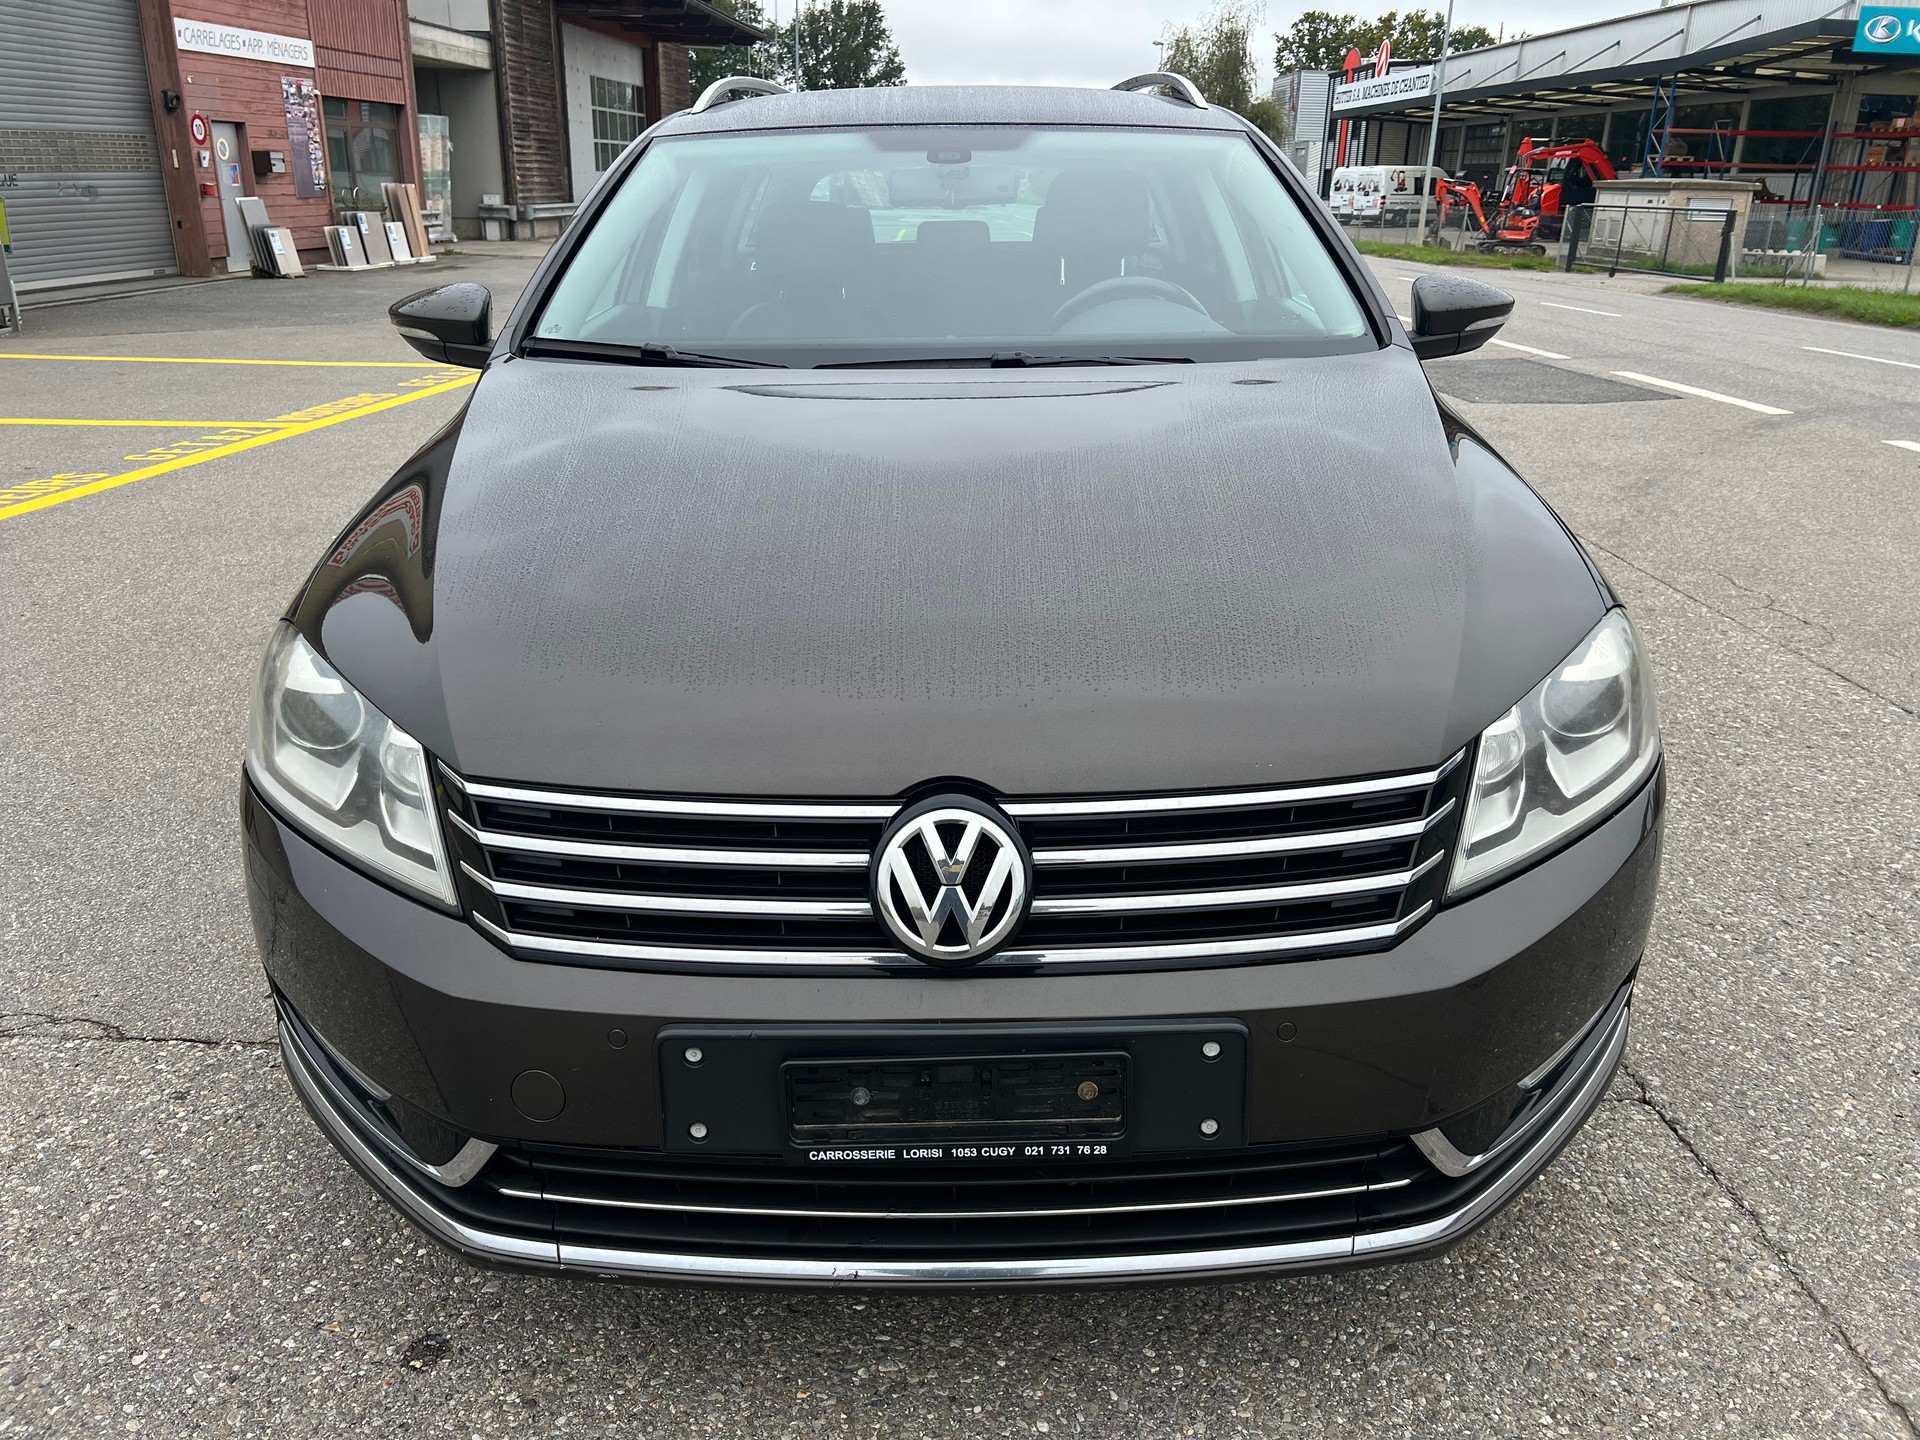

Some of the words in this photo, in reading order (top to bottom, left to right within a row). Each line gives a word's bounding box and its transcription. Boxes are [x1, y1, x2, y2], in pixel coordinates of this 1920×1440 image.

[183, 26, 241, 51] CARRELAGES
[247, 37, 265, 54] APP.
[267, 38, 308, 61] MÉNAGERS
[1362, 81, 1390, 100] MACHINES
[1390, 80, 1399, 95] DE
[1399, 74, 1430, 94] CHANTIER
[195, 123, 203, 136] 10
[0, 472, 109, 504] EURS
[123, 428, 274, 460] GETAZ
[809, 1149, 896, 1161] CARROSSERIE
[903, 1148, 943, 1159] LORISI
[951, 1147, 978, 1158] 1053
[981, 1146, 1016, 1157] CUGY
[1024, 1146, 1044, 1156] 021
[1051, 1145, 1071, 1156] 731
[1077, 1145, 1091, 1155] 76
[1093, 1145, 1107, 1155] 28
